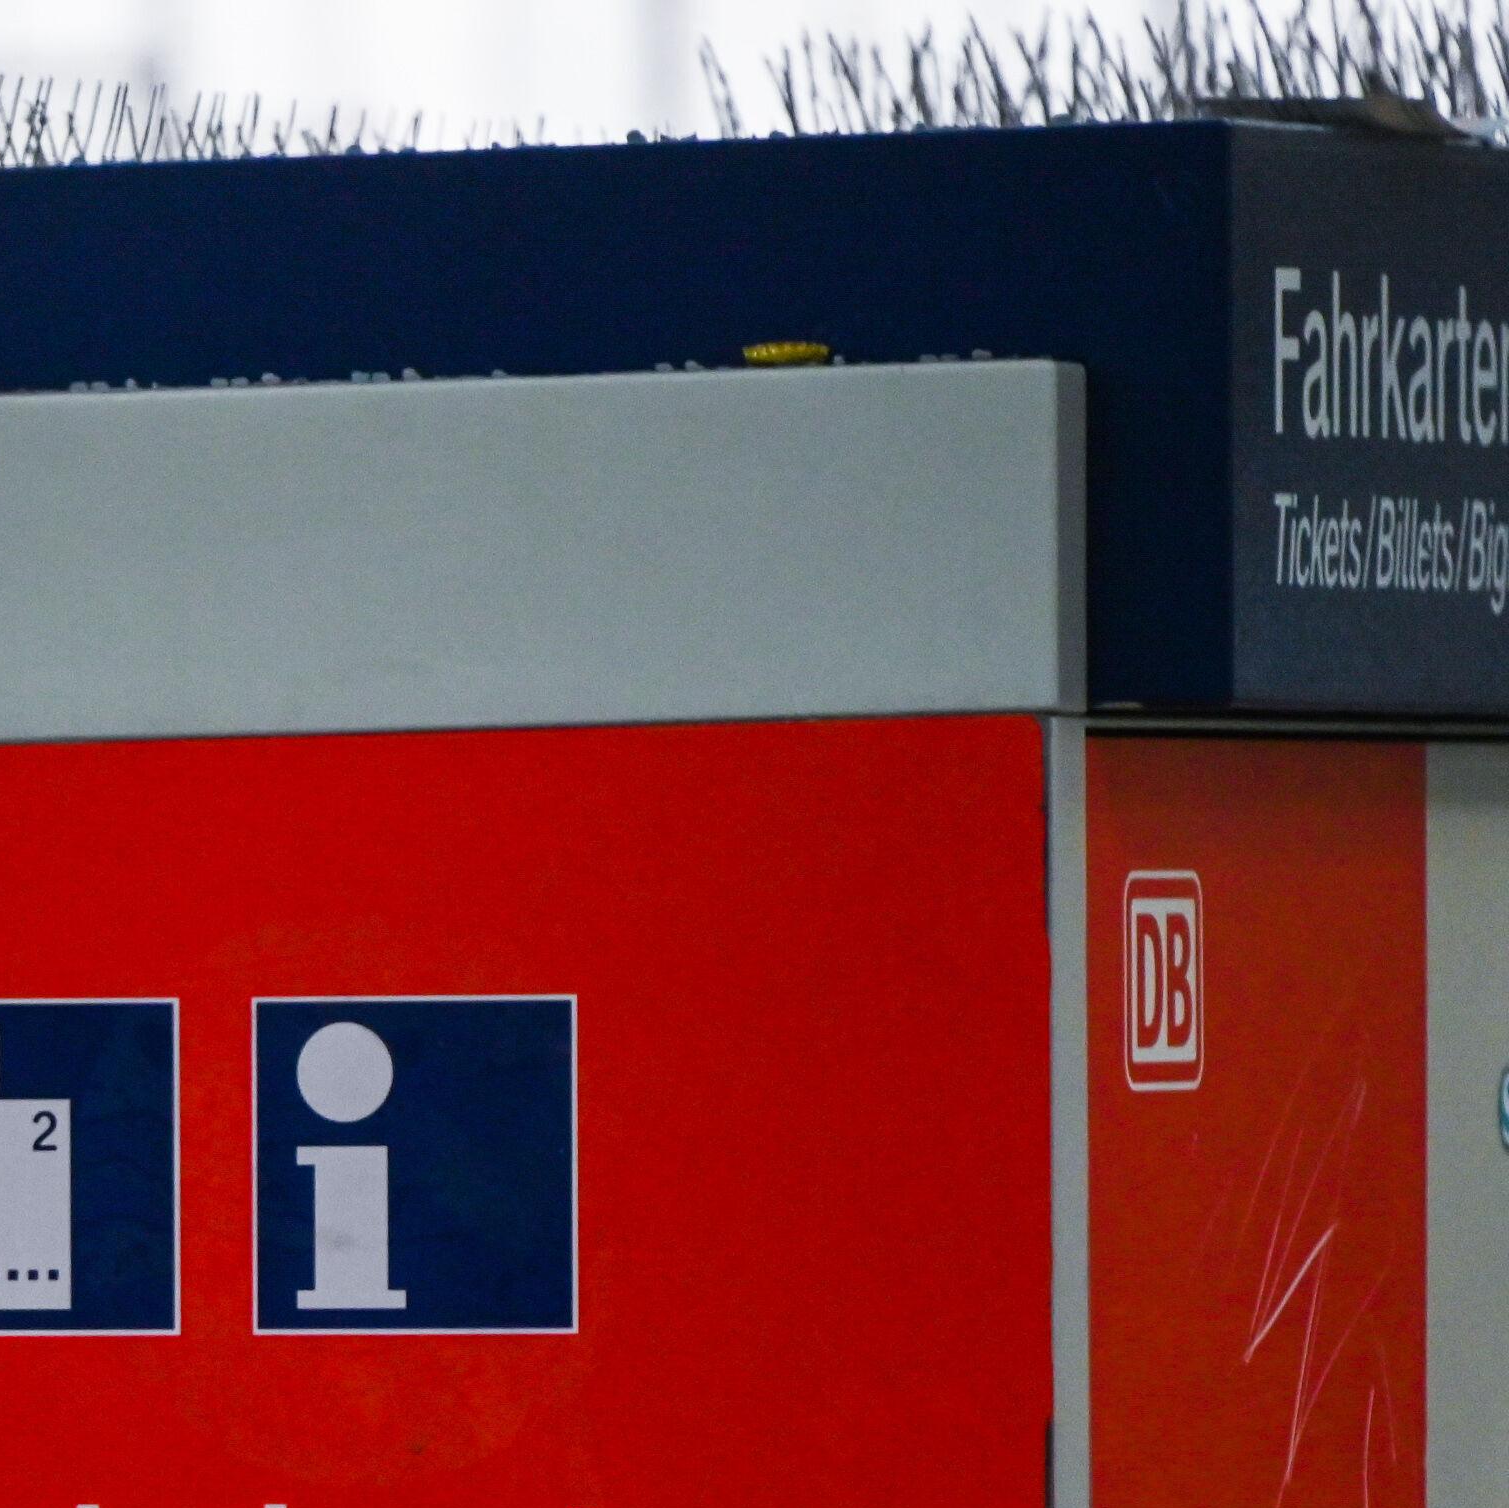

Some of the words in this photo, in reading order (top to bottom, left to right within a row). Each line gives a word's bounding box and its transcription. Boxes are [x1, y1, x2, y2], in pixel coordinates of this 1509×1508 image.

[1274, 266, 1509, 446] Fahrkarte
[1136, 912, 1193, 1049] DB
[31, 1110, 58, 1152] 2
